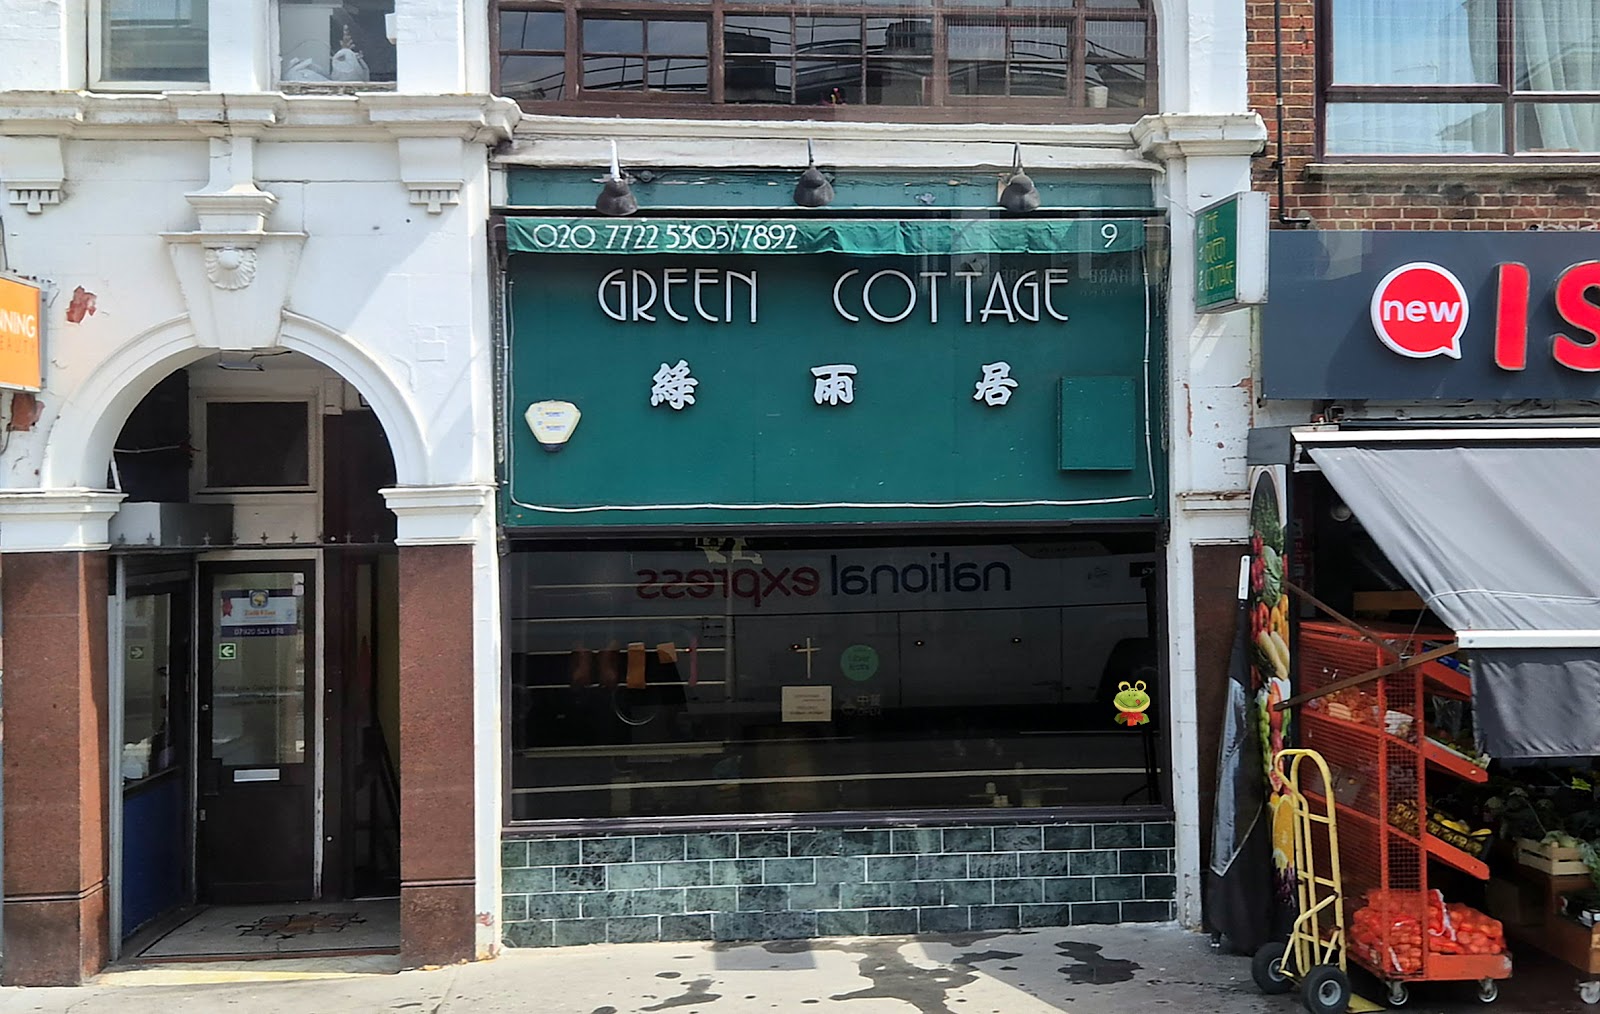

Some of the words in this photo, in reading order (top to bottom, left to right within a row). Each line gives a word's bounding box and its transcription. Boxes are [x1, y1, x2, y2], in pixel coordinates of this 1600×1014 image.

[533, 223, 596, 249] 020
[605, 224, 658, 249] 7722
[666, 223, 798, 251] 5305/7892
[1101, 223, 1118, 249] 9
[597, 268, 758, 323] GREEN
[833, 268, 1069, 323] COTTAGE
[1382, 299, 1461, 323] new
